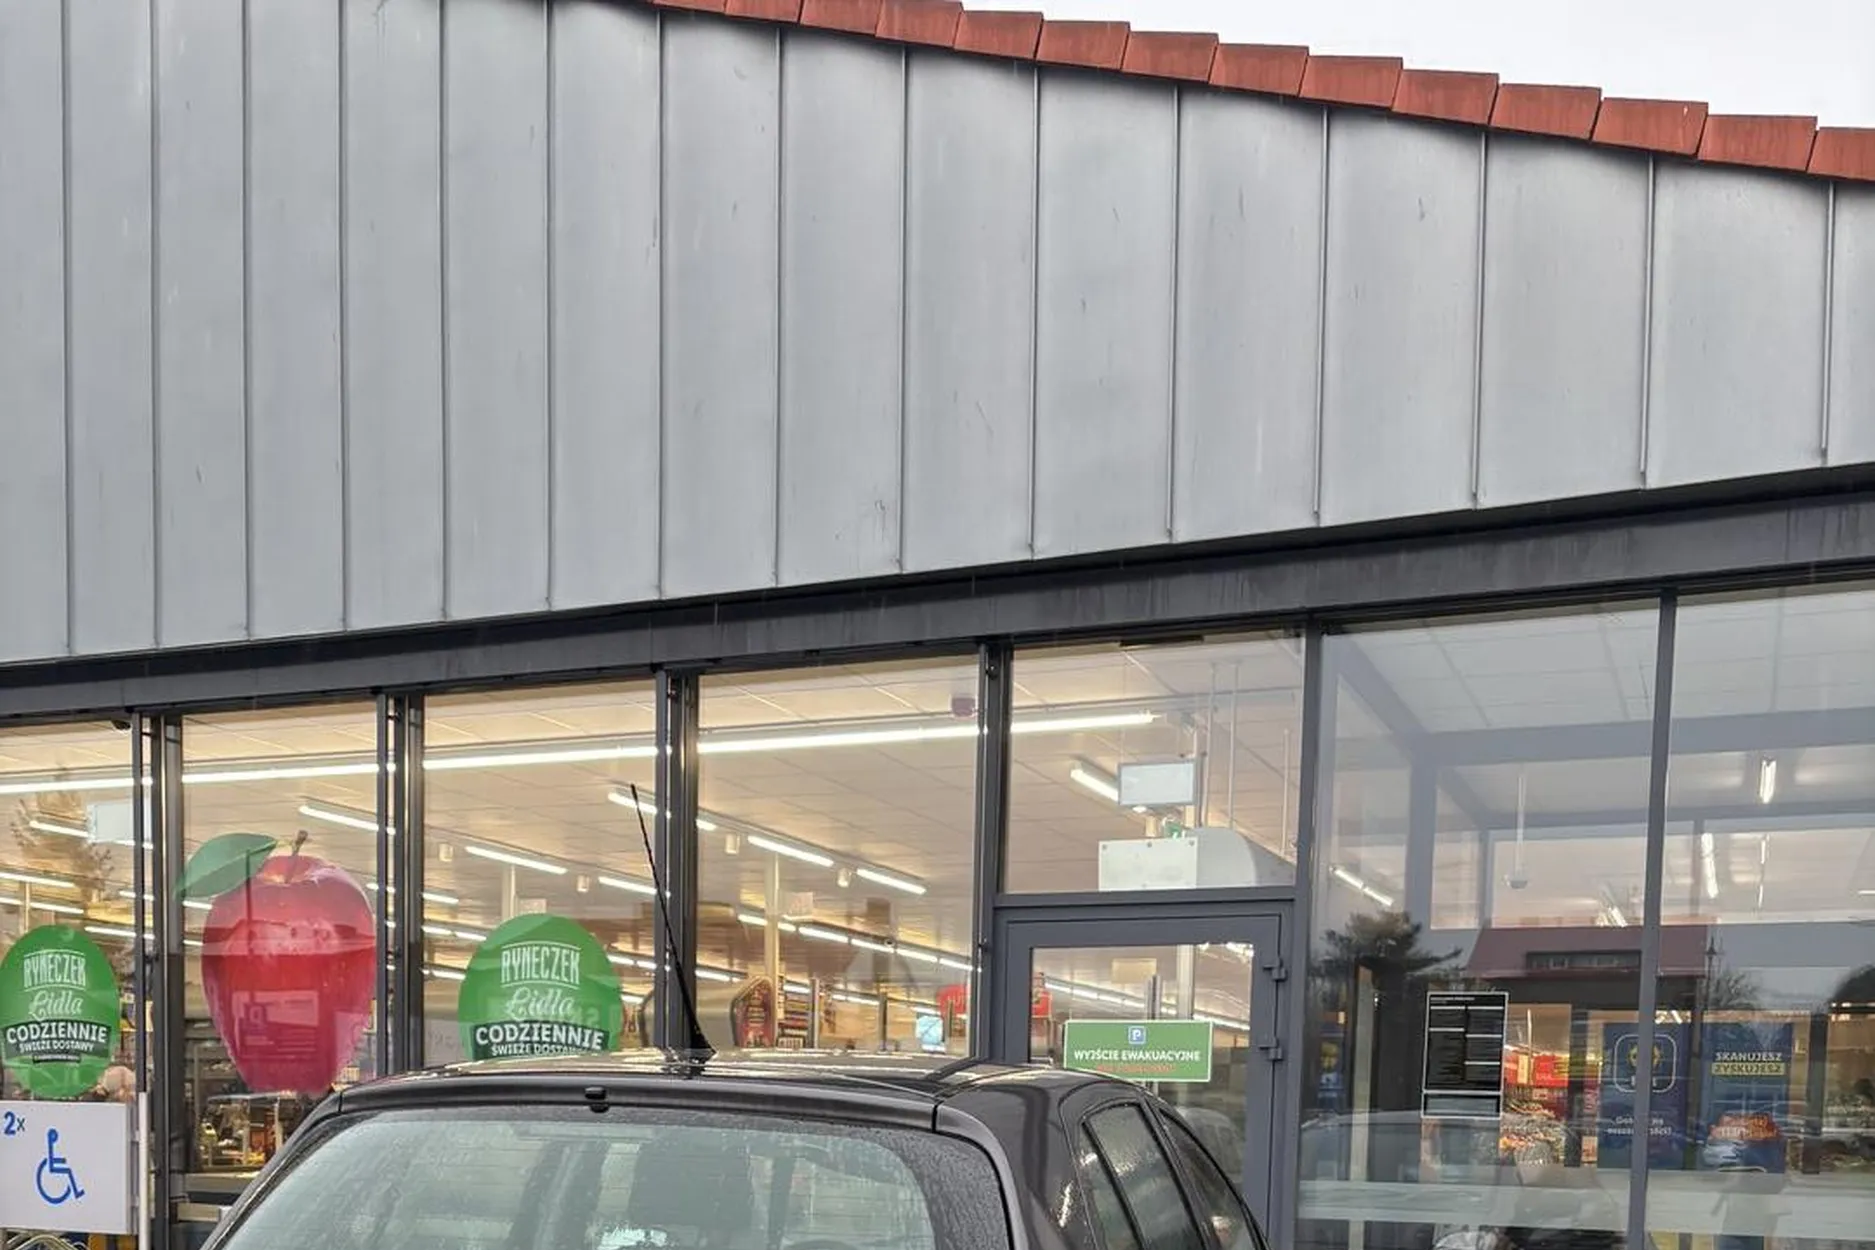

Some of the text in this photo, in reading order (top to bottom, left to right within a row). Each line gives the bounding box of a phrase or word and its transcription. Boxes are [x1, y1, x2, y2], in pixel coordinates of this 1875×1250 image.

[23, 954, 86, 988] RYNECZEK
[501, 946, 581, 985] RYNECZEK
[28, 990, 84, 1021] Lidla
[504, 986, 575, 1021] Lidla
[6, 1022, 108, 1043] CODZIENNIE
[475, 1023, 605, 1050] CODZIENNIE
[52, 1039, 95, 1052] DOSTAWY
[1074, 1048, 1201, 1062] WYJŚCIE EWAKUACYJNE
[1715, 1052, 1783, 1062] SKANUJESZ
[1714, 1063, 1782, 1074] ZYSKUJESZ
[4, 1111, 26, 1135] 2x
